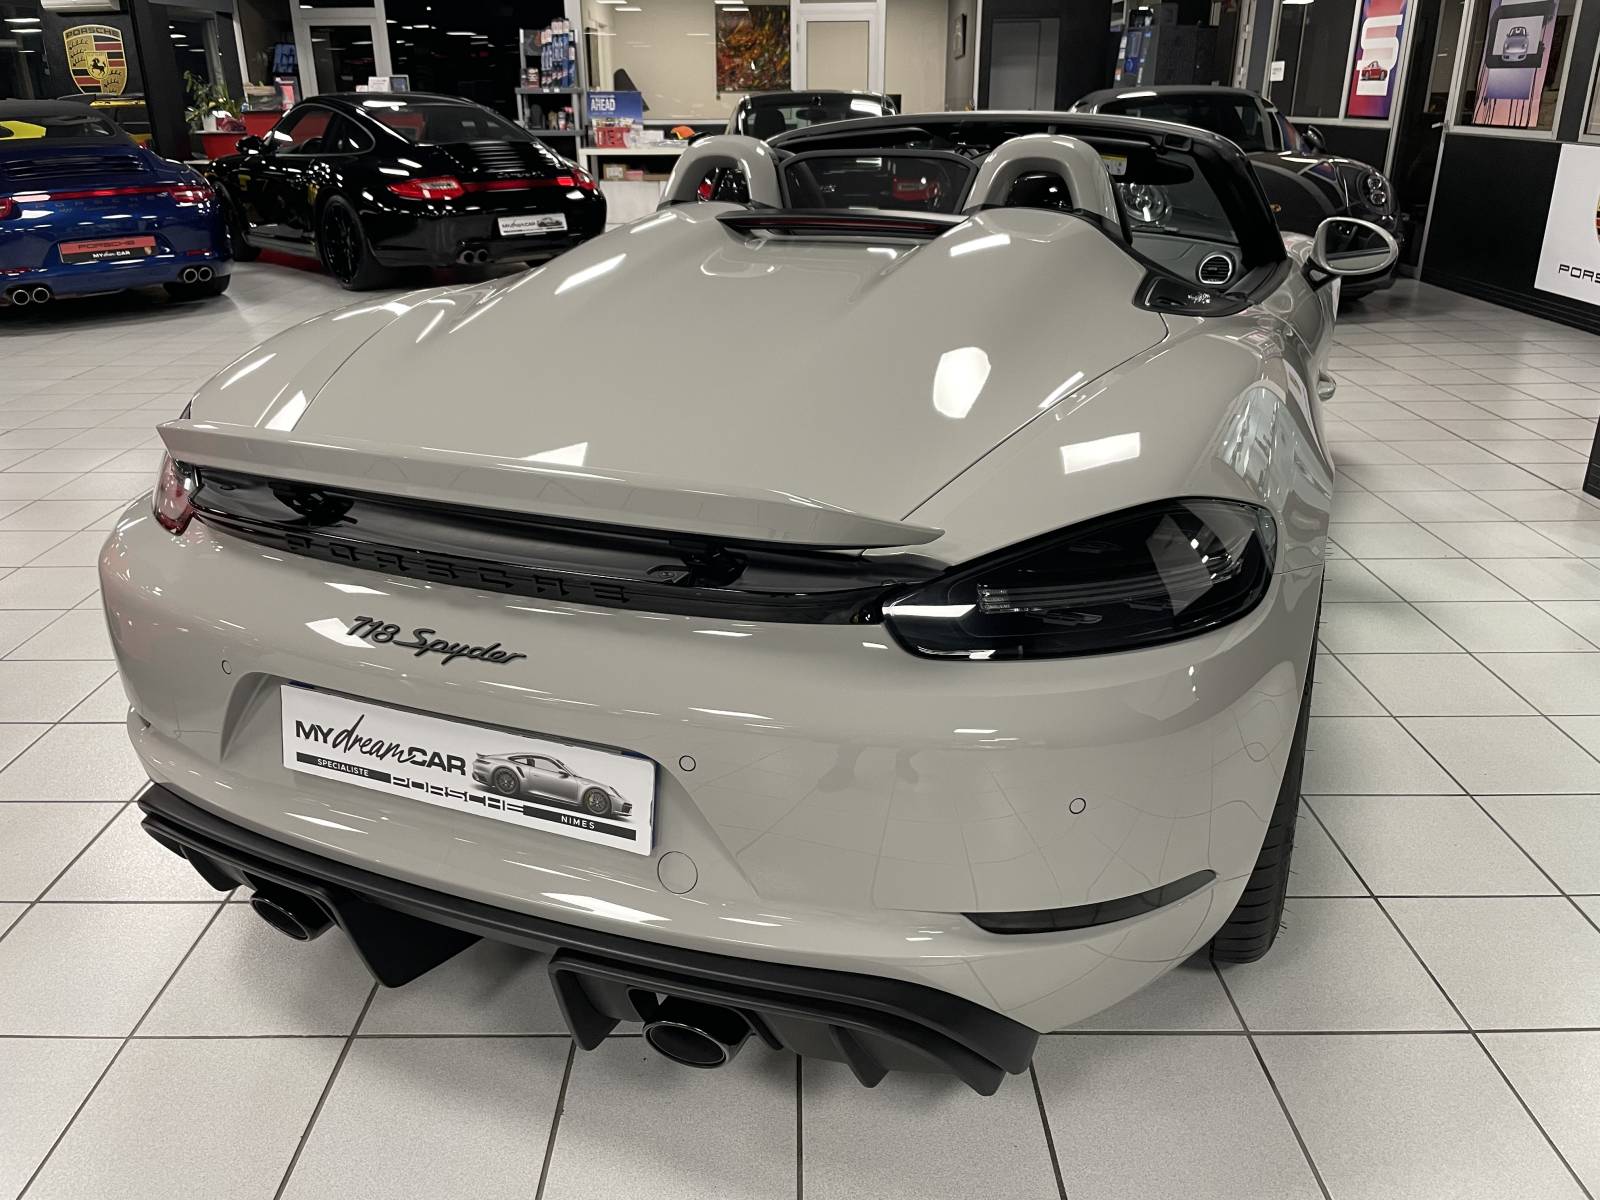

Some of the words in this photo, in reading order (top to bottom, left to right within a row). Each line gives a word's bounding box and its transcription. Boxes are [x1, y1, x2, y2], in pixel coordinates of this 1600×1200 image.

[65, 27, 120, 38] PORSCHE
[590, 98, 616, 111] AHEAD
[78, 241, 136, 249] PORSCHE
[347, 615, 401, 643] 718
[392, 628, 527, 666] Spyder
[295, 720, 334, 744] MY
[332, 714, 416, 761] dream
[407, 746, 466, 776] CAR
[317, 758, 370, 777] SPECIALISTE
[391, 774, 524, 814] PORSCHE
[561, 814, 596, 830] NIMES
